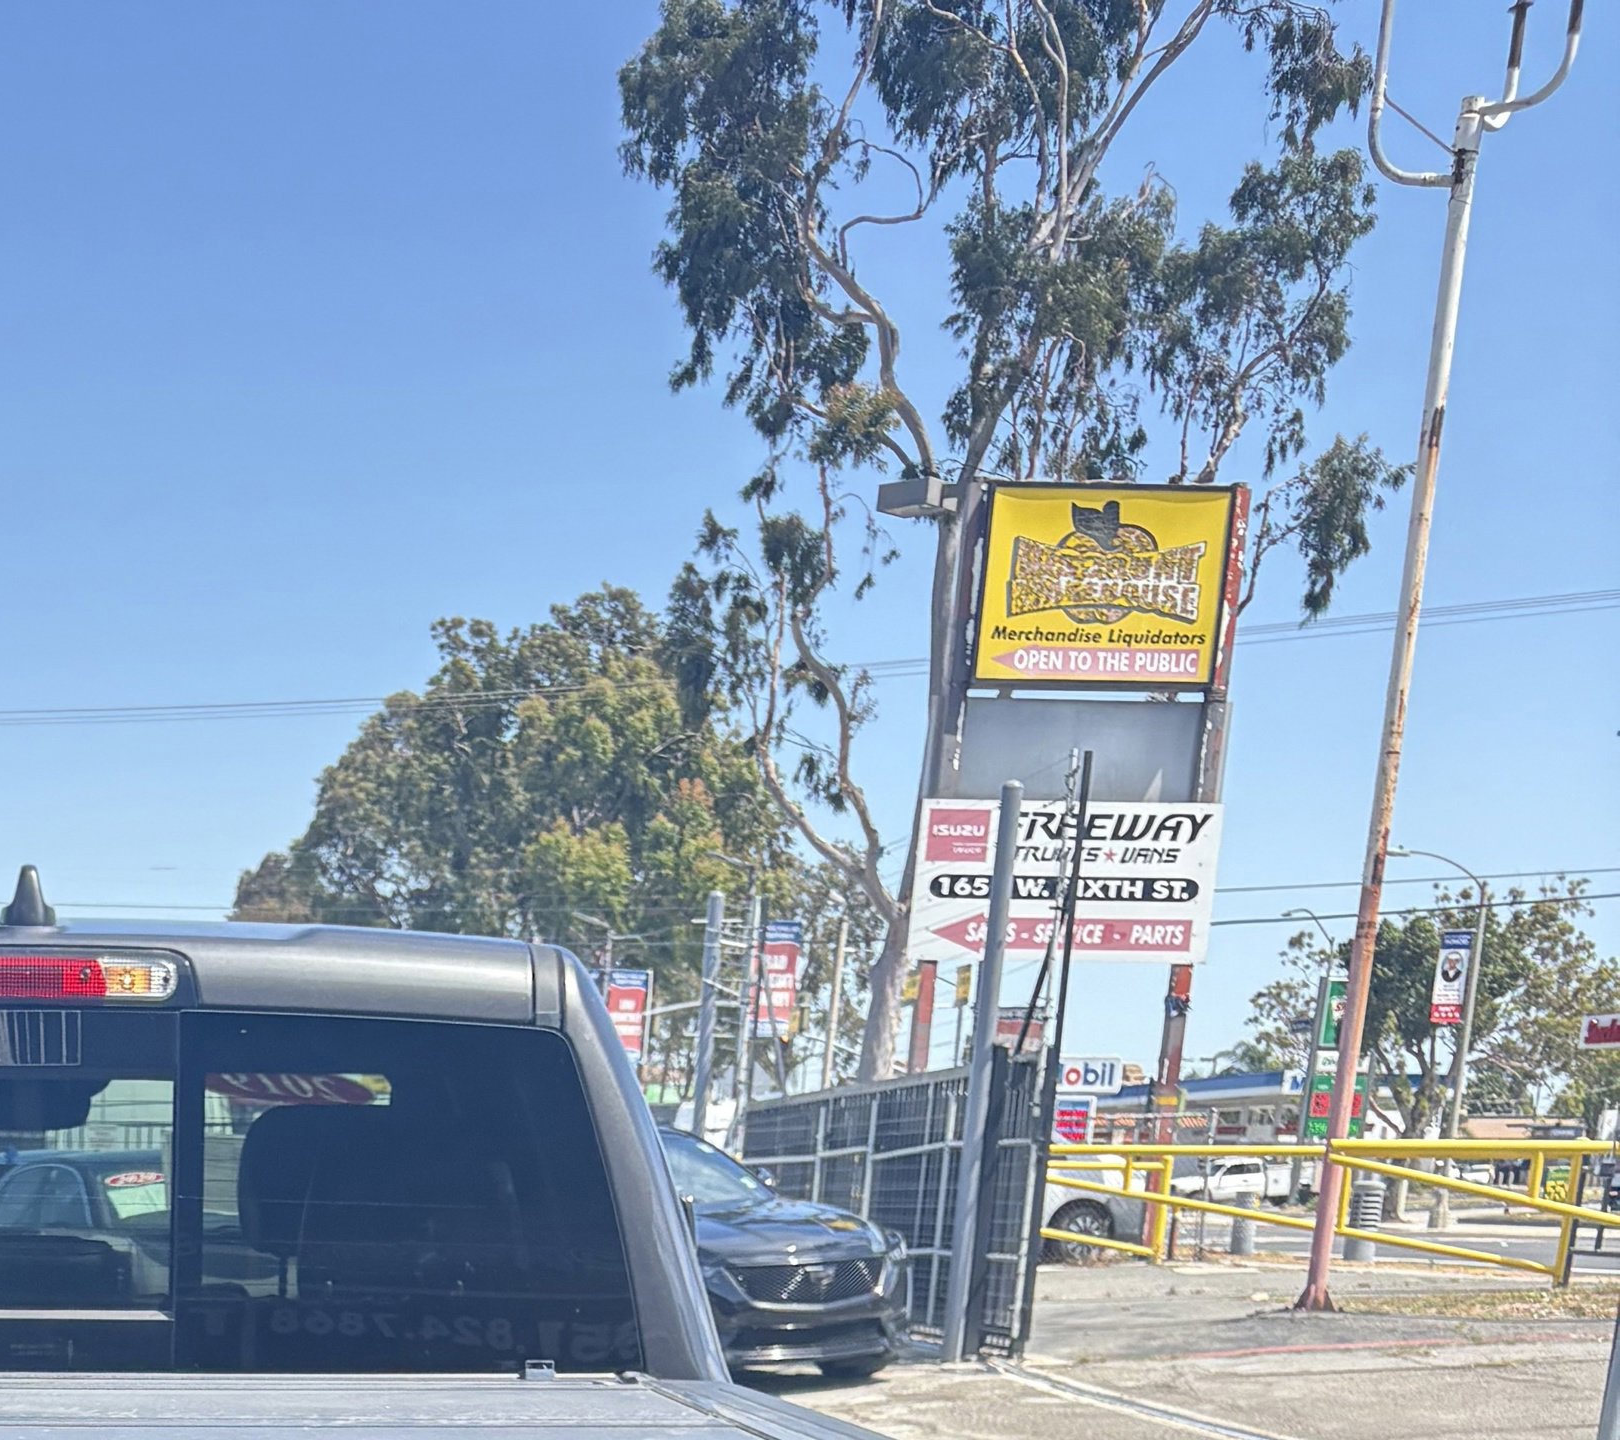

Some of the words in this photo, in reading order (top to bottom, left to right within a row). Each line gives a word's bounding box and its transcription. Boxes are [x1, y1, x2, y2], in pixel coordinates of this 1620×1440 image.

[991, 625, 1102, 643] Merchandise
[1108, 628, 1206, 648] Liquidators
[1013, 649, 1063, 671] OPEN
[1068, 651, 1091, 672] TO
[1097, 651, 1130, 672] THE
[1134, 652, 1197, 673] PUBLIC
[932, 824, 985, 837] ISUZU
[1014, 845, 1102, 862] TRUS
[938, 876, 990, 896] 165
[1016, 878, 1050, 897] W.
[1062, 878, 1144, 899] IXTH
[1151, 880, 1189, 900] ST.
[964, 922, 1017, 943] SAS
[1033, 923, 1104, 944] SEICE
[1130, 924, 1185, 945] PARTS
